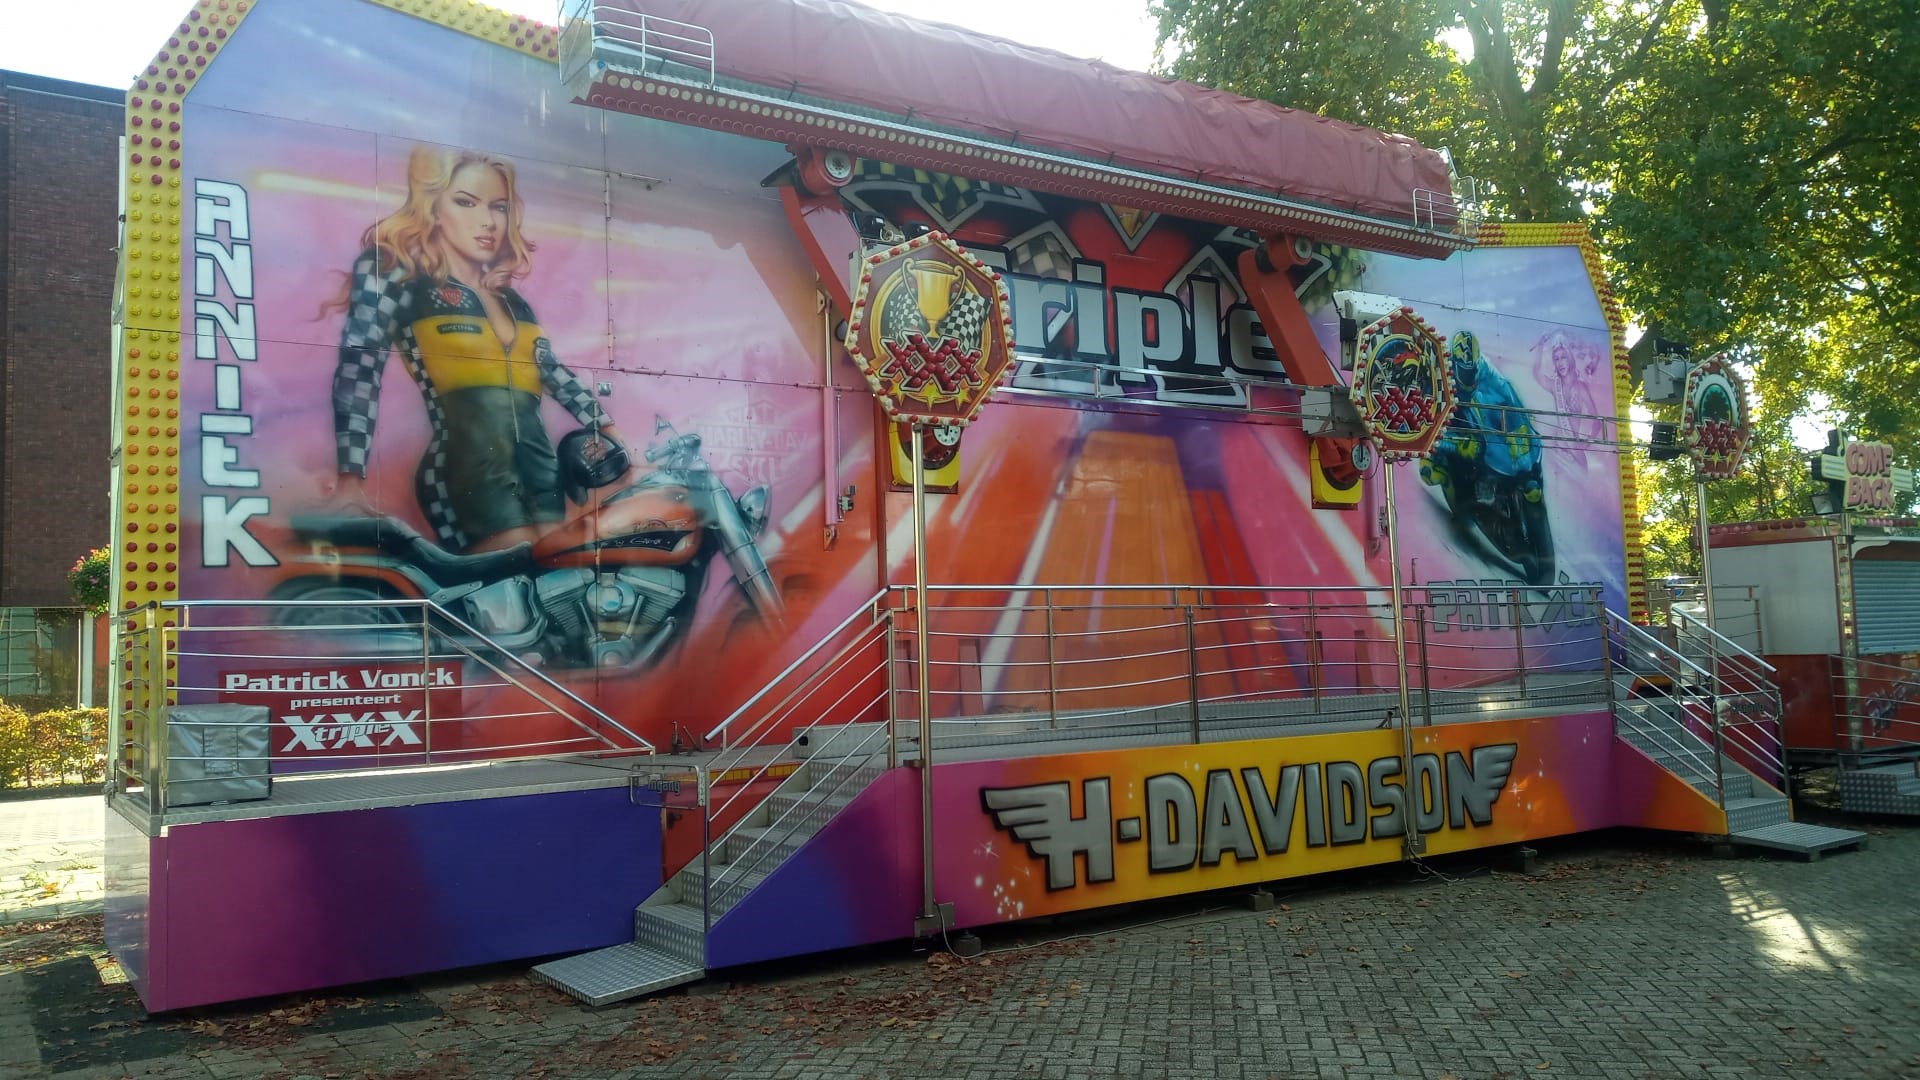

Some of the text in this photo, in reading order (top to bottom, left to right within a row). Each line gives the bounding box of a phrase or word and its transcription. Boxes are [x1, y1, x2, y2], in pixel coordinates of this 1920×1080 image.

[966, 245, 1286, 387] riple
[194, 177, 281, 569] ANNIEK
[1846, 443, 1893, 477] COME
[1847, 477, 1896, 511] BACK
[225, 667, 455, 694] Patrick Vonck
[291, 693, 401, 710] presenteert
[981, 742, 1519, 892] H-DAVIDSON
